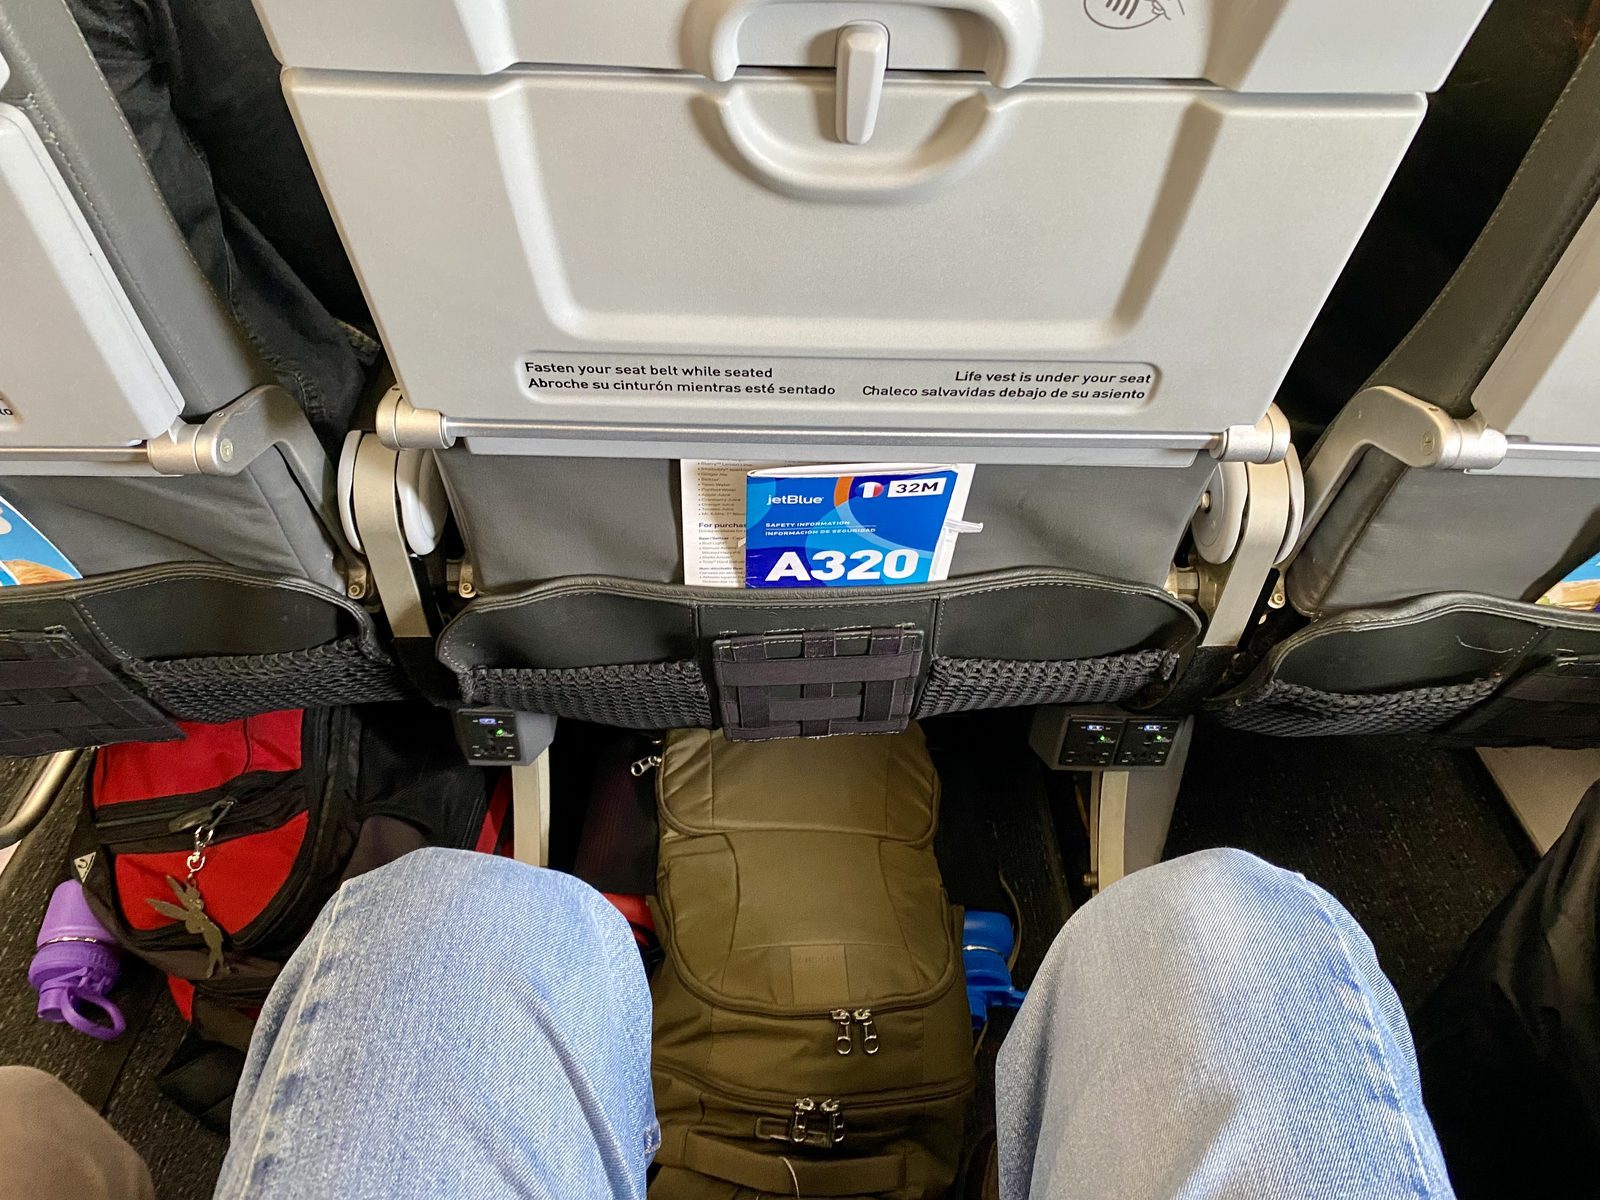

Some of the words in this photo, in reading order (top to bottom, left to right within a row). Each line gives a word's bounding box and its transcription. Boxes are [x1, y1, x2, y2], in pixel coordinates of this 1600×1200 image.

[524, 361, 575, 374] Fasten
[577, 365, 612, 376] your
[615, 365, 647, 375] seat
[649, 364, 679, 376] belt
[681, 365, 721, 377] while
[724, 367, 773, 378] seated
[955, 370, 982, 382] Life
[986, 372, 1016, 382] vest
[1019, 371, 1032, 382] is
[1035, 372, 1080, 383] under
[1081, 375, 1117, 386] your
[1119, 374, 1152, 384] seat
[528, 377, 589, 389] Abroche
[592, 381, 610, 390] su
[613, 379, 673, 392] cinturón
[677, 381, 742, 393] mientras
[744, 382, 775, 394] esté
[778, 384, 836, 395] sentado
[862, 385, 918, 397] Chaleco
[921, 386, 996, 398] salvavidas
[998, 387, 1047, 400] debajo
[1050, 387, 1069, 398] de
[1071, 390, 1089, 399] su
[1092, 388, 1145, 399] asiento
[895, 481, 939, 494] 32M
[766, 494, 823, 505] jetBlue
[796, 520, 851, 528] INFORMATION
[765, 529, 819, 537] INFORMACIÓN
[831, 527, 877, 535] SEGURIDAD
[765, 550, 919, 581] A320
